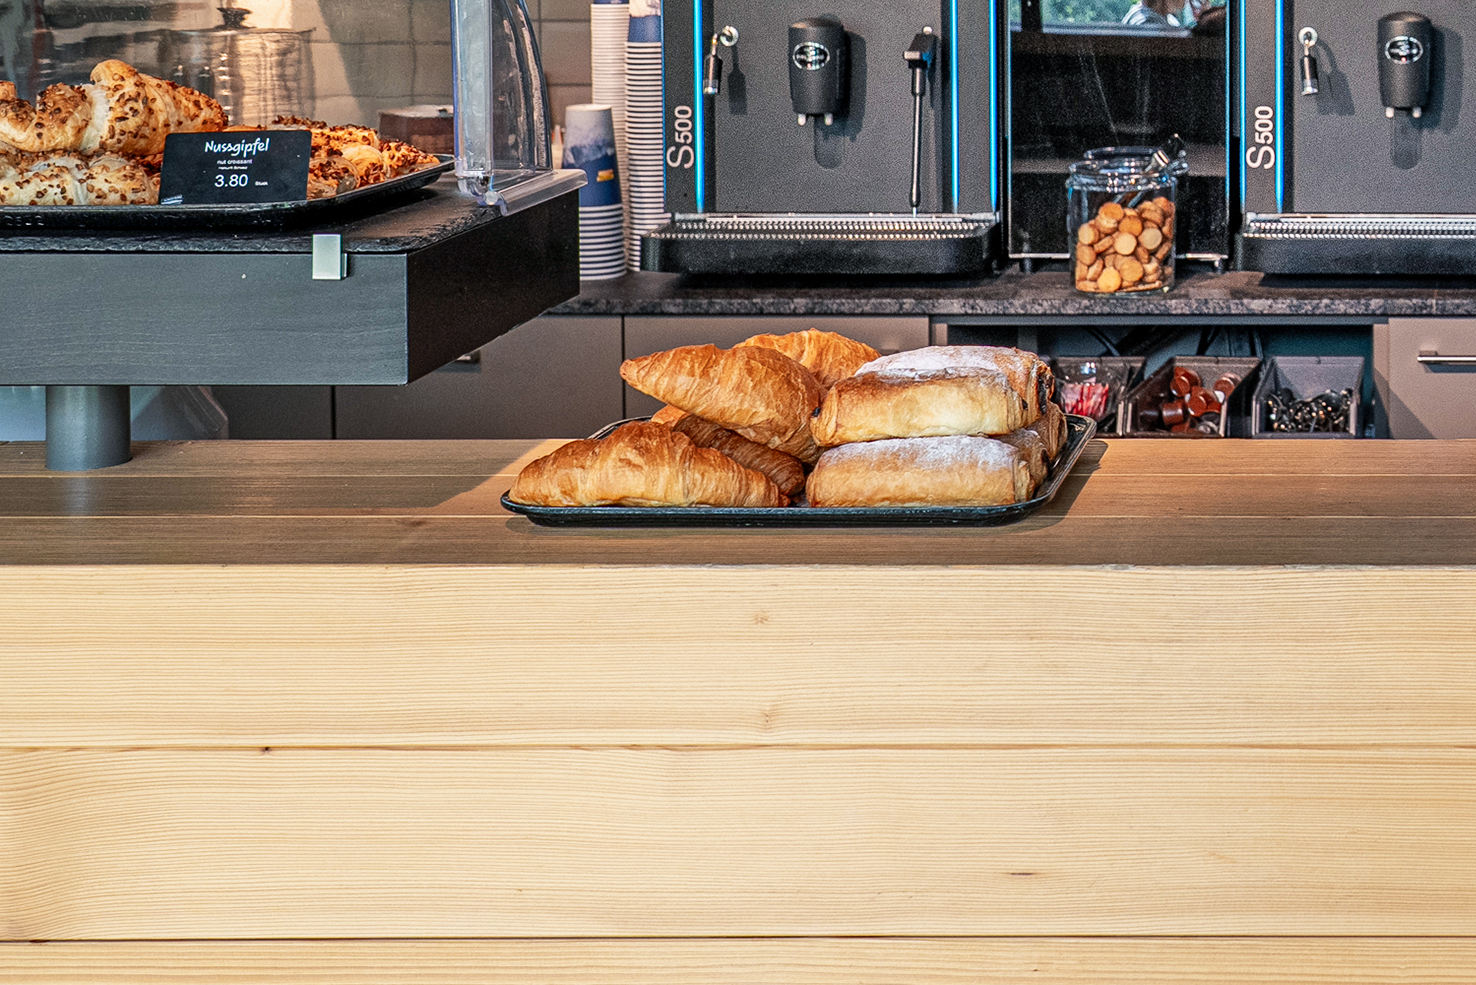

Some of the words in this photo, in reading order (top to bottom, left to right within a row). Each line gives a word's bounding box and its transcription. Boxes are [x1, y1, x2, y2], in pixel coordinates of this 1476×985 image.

[205, 137, 270, 158] Nussgipfel
[1246, 105, 1275, 169] S500
[214, 174, 249, 187] 3.80
